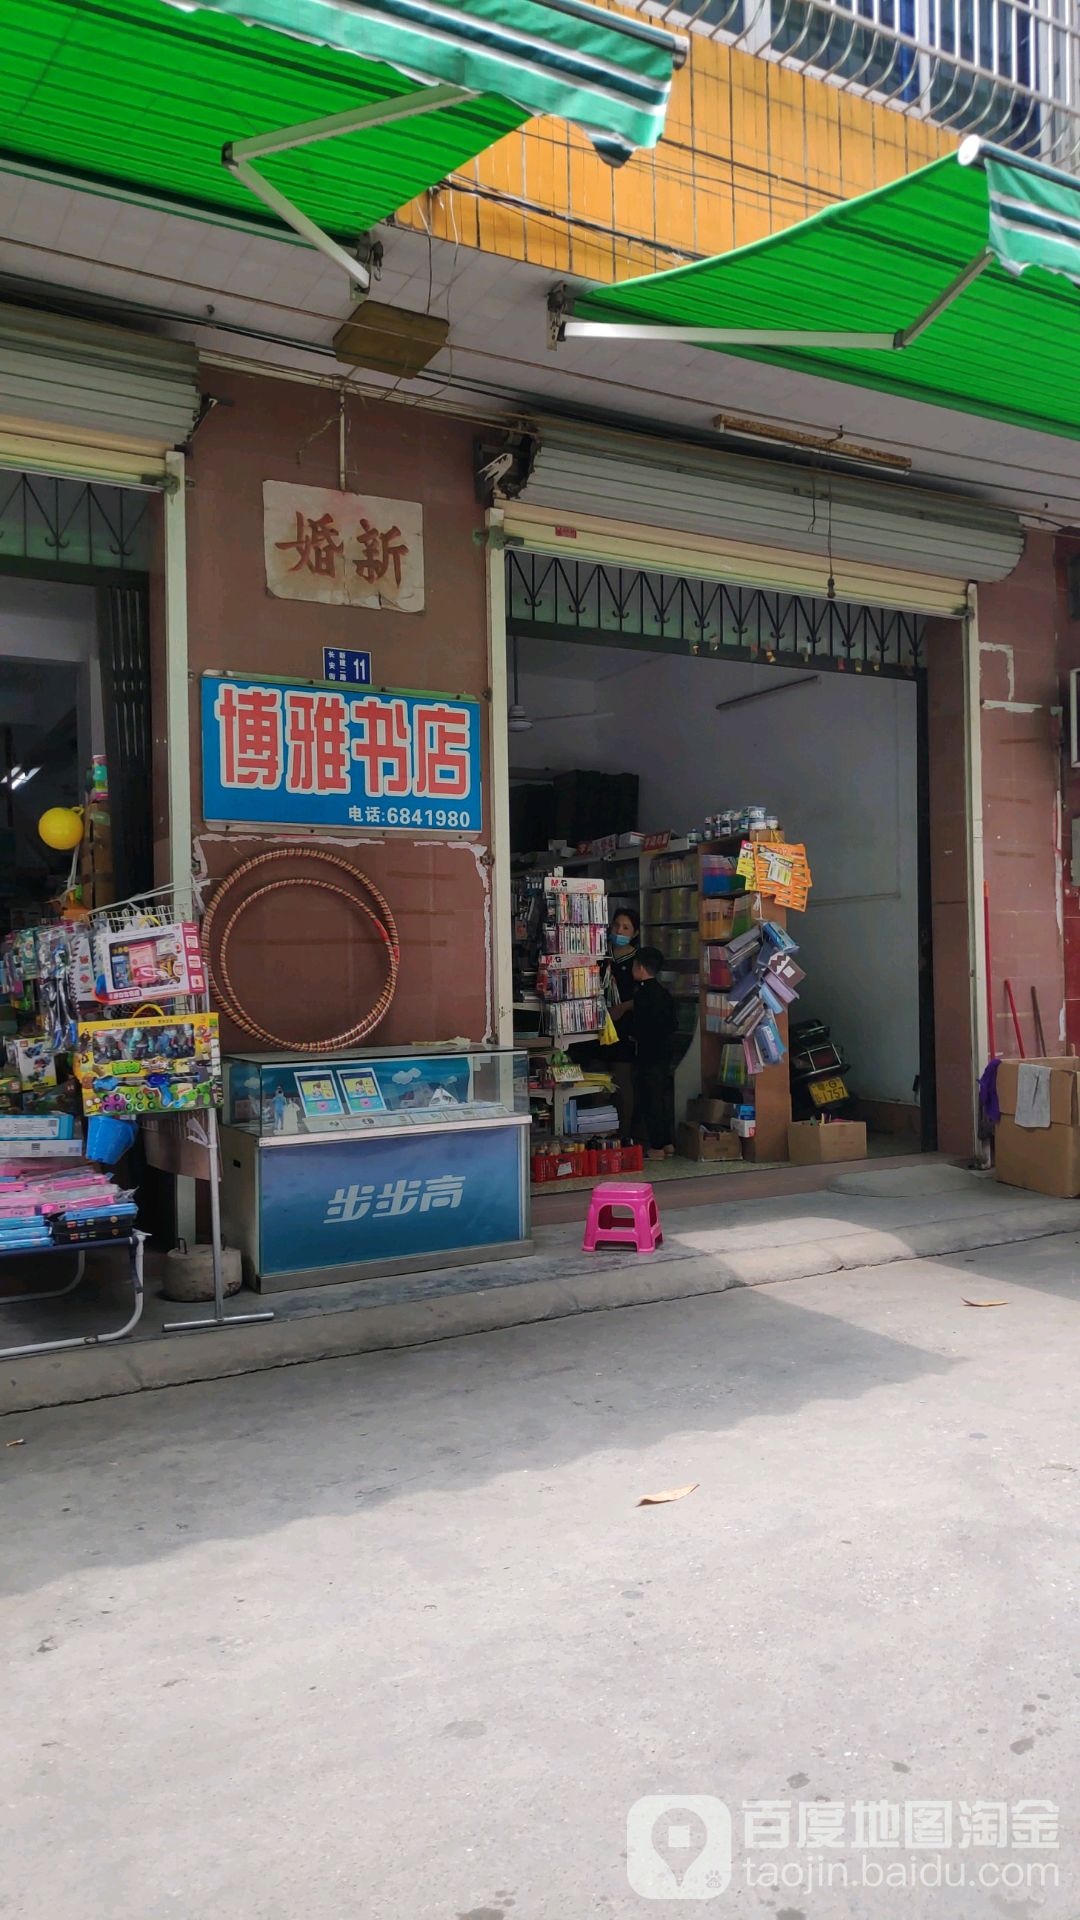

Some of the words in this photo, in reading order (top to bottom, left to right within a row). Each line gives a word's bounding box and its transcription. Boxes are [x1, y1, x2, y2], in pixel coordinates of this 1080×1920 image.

[353, 658, 366, 680] 11
[215, 683, 471, 799] 博雅书店
[323, 1175, 467, 1224] 步步高
